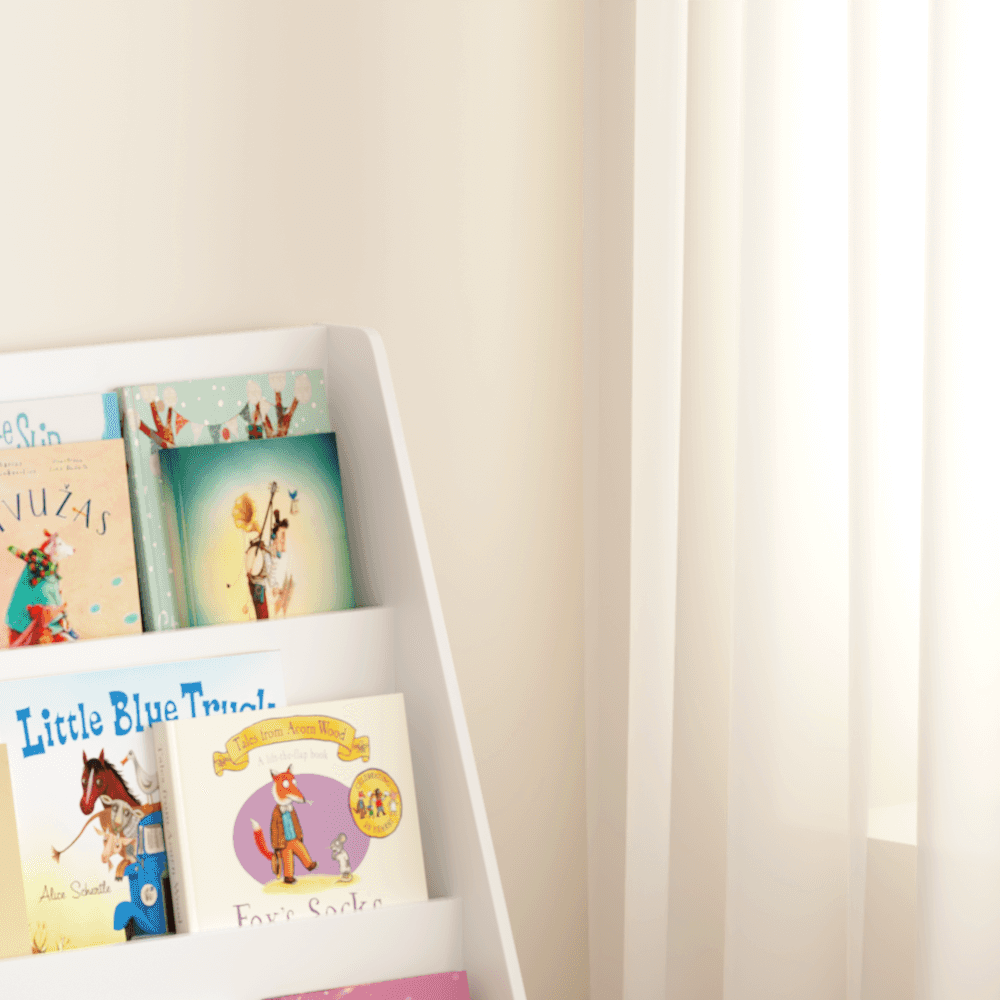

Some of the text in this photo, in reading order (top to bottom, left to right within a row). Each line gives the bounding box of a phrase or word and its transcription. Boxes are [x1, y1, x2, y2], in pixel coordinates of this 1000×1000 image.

[16, 702, 103, 758] Little
[109, 690, 179, 736] Blue
[233, 720, 347, 751] Tales from Acorn Wood
[39, 884, 66, 902] Alice
